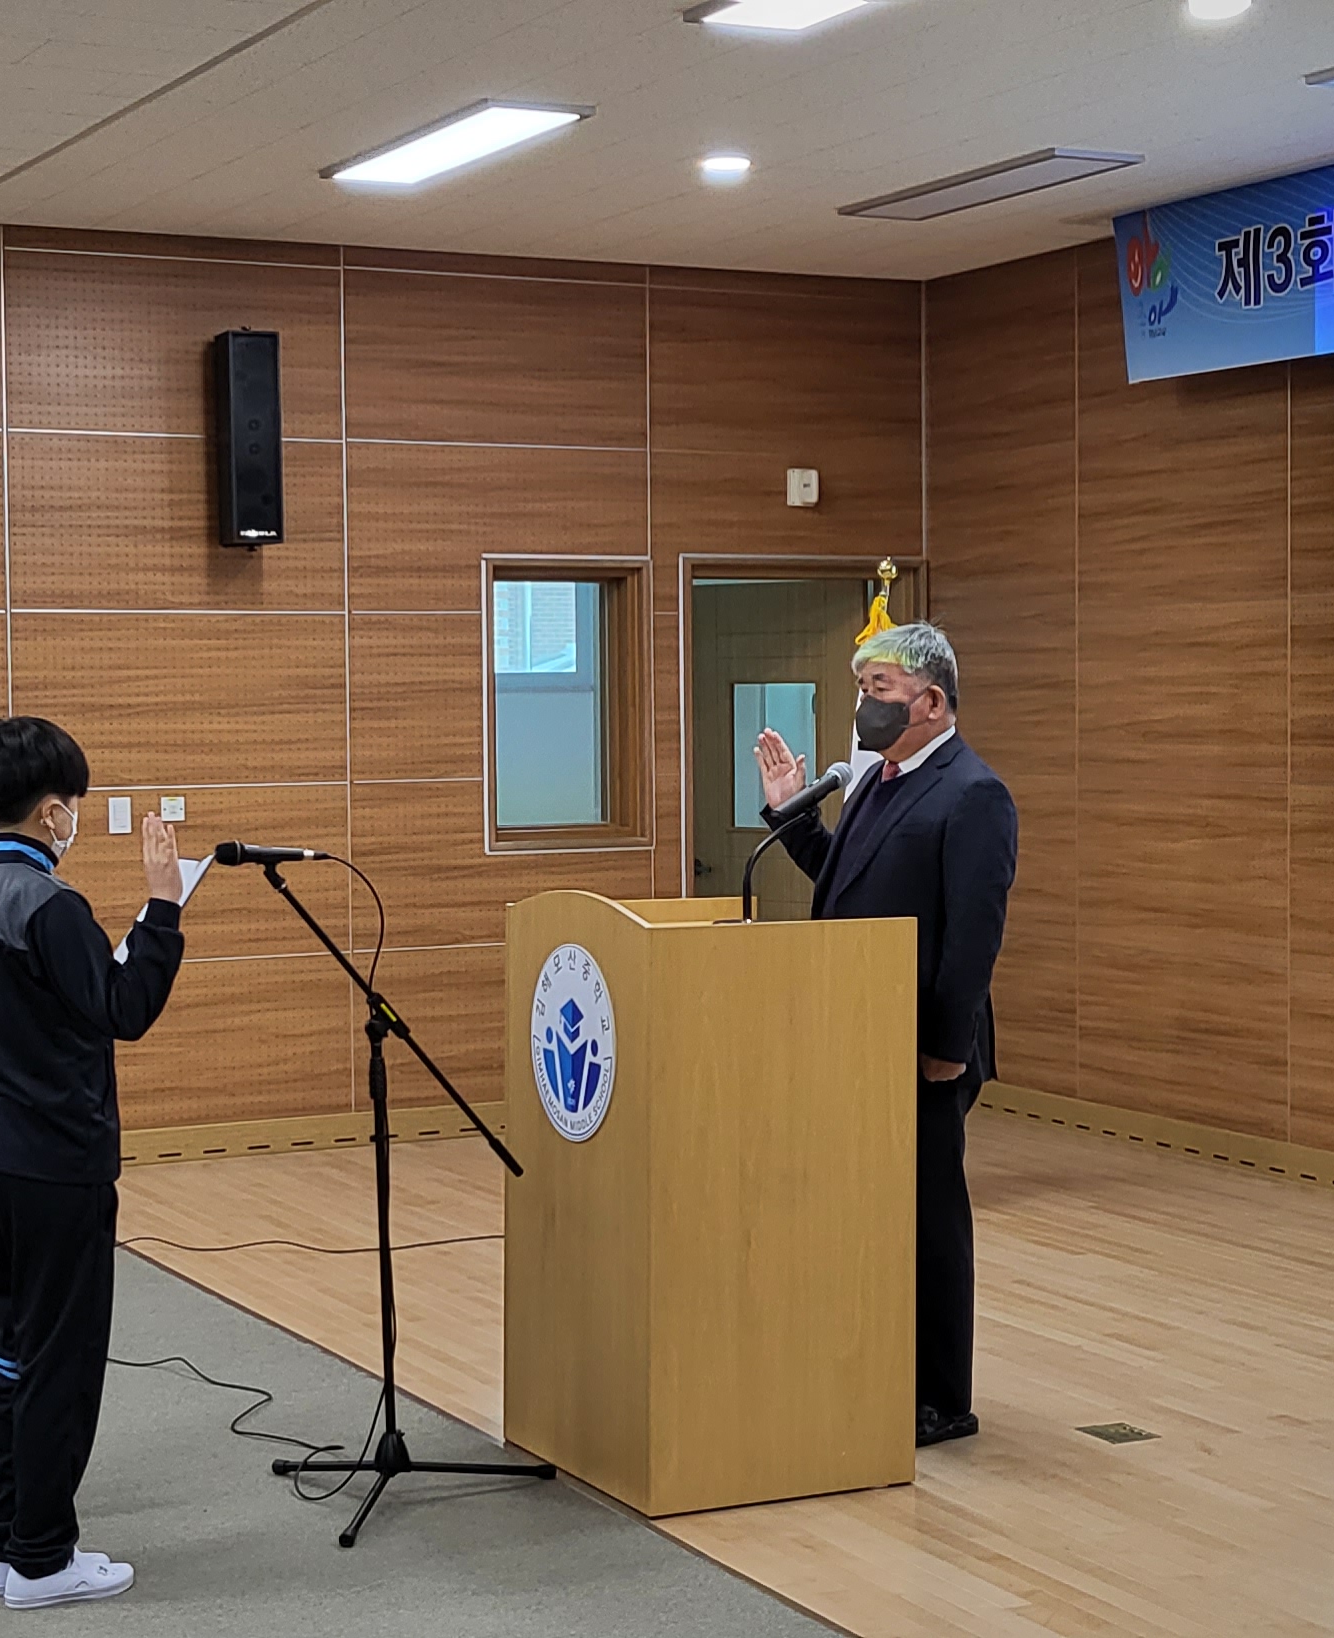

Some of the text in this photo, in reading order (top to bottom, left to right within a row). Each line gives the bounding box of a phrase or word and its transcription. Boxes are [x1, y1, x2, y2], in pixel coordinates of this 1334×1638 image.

[536, 950, 610, 1034] 김해모산중학교
[534, 1045, 610, 1131] GIMHAEMOSAN MIDDLE SCHOOL
